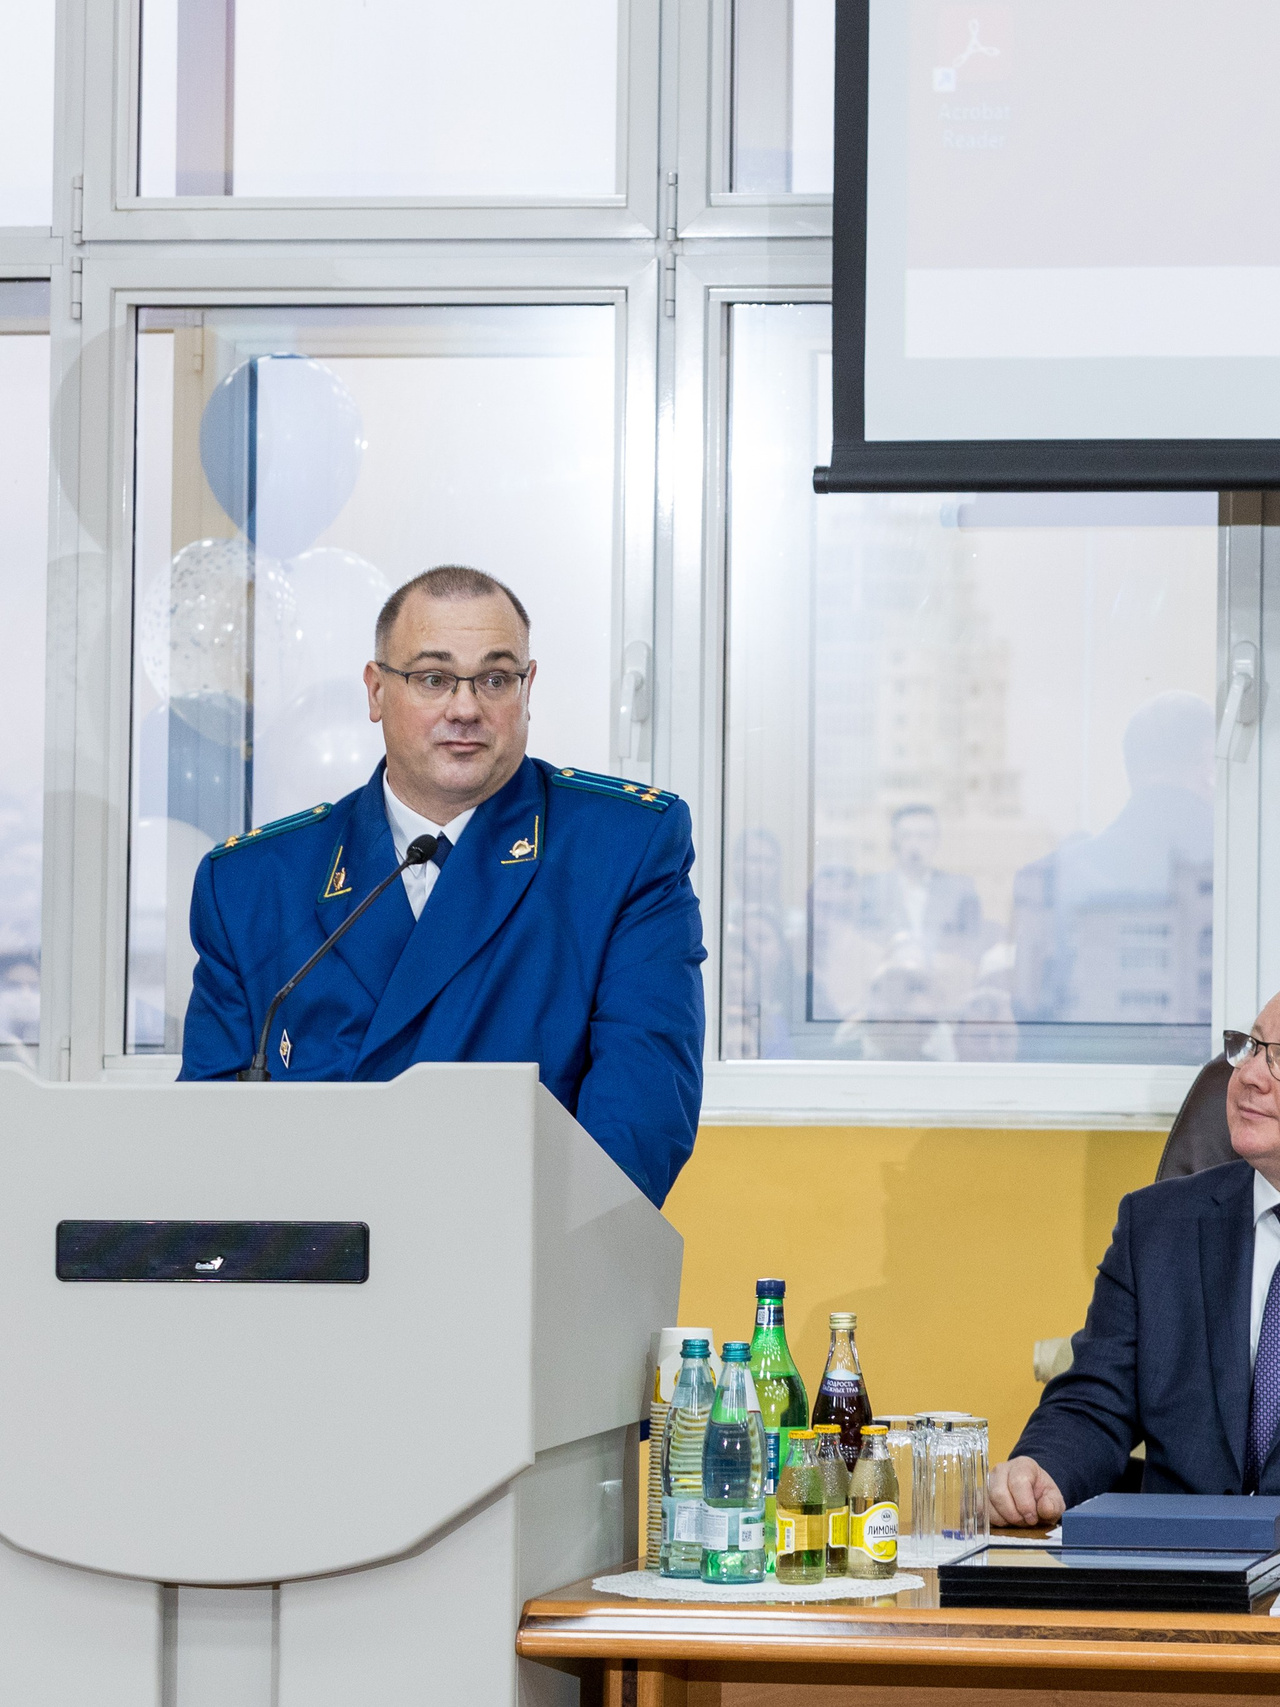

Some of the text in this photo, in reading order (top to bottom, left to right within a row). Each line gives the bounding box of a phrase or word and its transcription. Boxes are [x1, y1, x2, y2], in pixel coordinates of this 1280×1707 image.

[938, 102, 1011, 120] Acrobat
[941, 129, 1006, 149] Reader
[867, 1523, 897, 1536] ЛИМОНА
